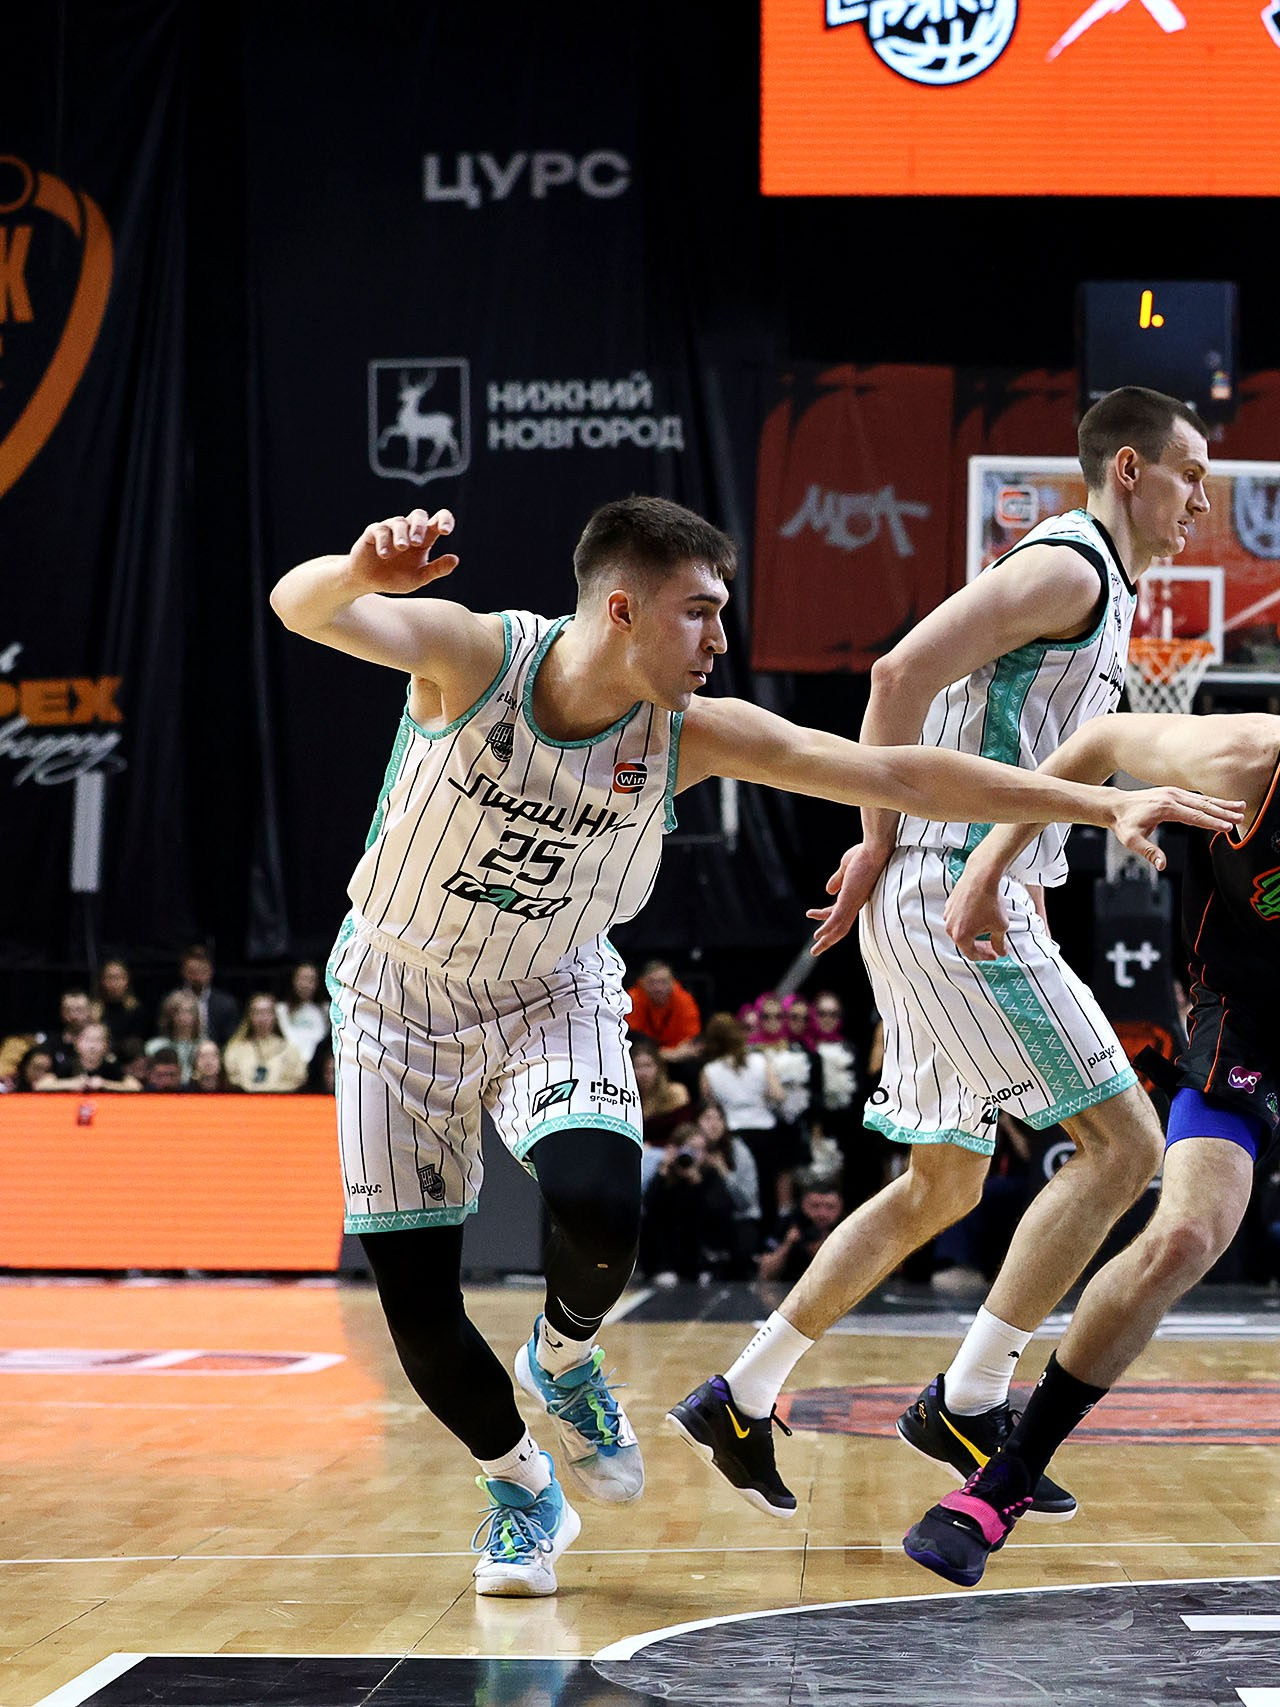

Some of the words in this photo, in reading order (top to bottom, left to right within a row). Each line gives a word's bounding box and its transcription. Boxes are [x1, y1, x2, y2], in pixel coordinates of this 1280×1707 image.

[423, 151, 632, 209] ЦУРС
[487, 370, 653, 412] НИЖНИЙ
[487, 415, 685, 451] НОВГОРОД
[478, 829, 579, 887] 25
